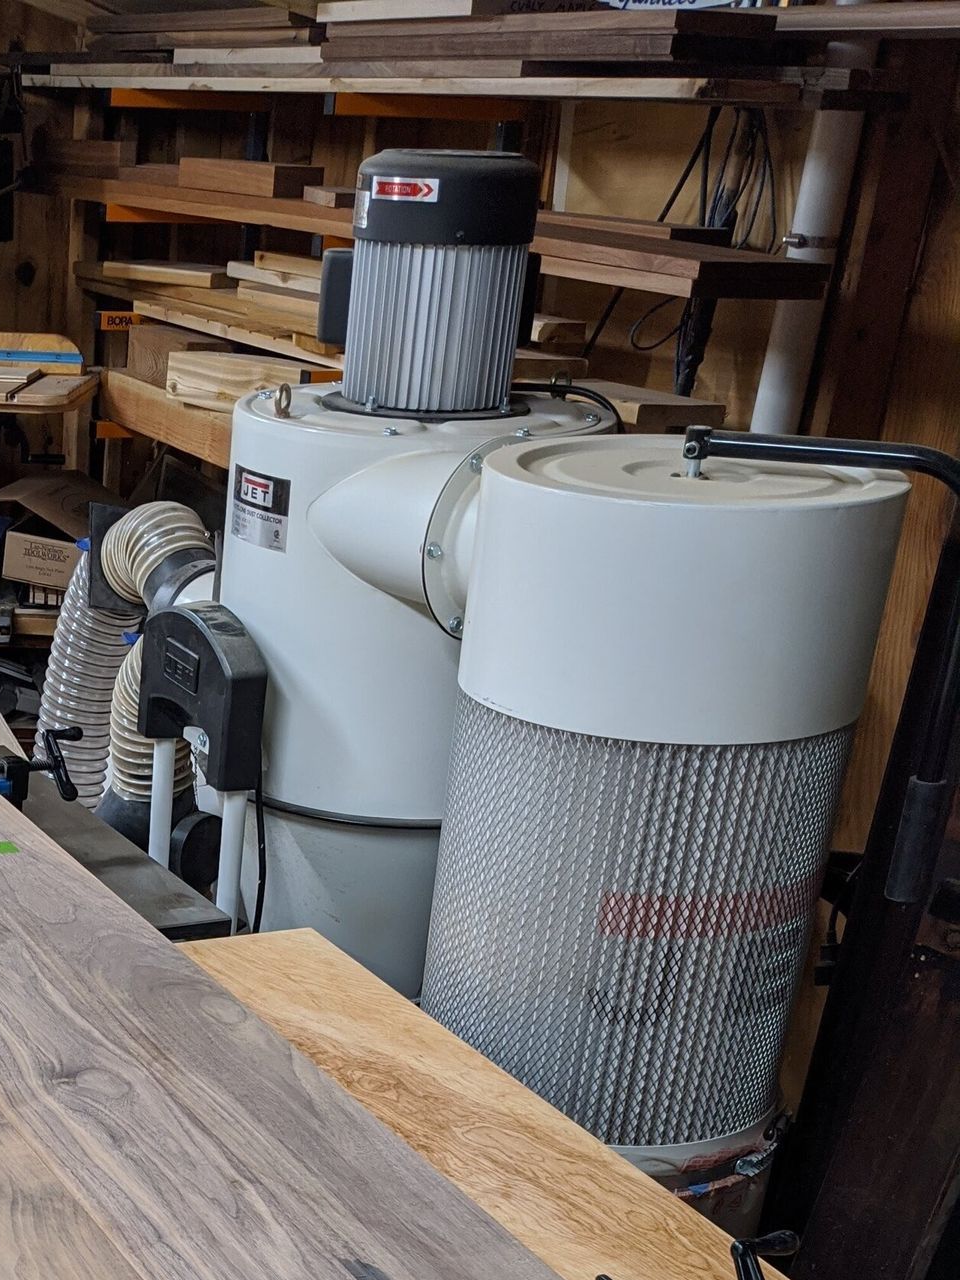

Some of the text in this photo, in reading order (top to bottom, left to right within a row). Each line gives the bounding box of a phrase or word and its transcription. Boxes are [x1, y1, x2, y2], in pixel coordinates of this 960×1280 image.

[384, 184, 412, 194] ROTATION
[107, 315, 133, 326] BORA
[243, 485, 270, 503] JET
[256, 512, 283, 525] COLLECTOR
